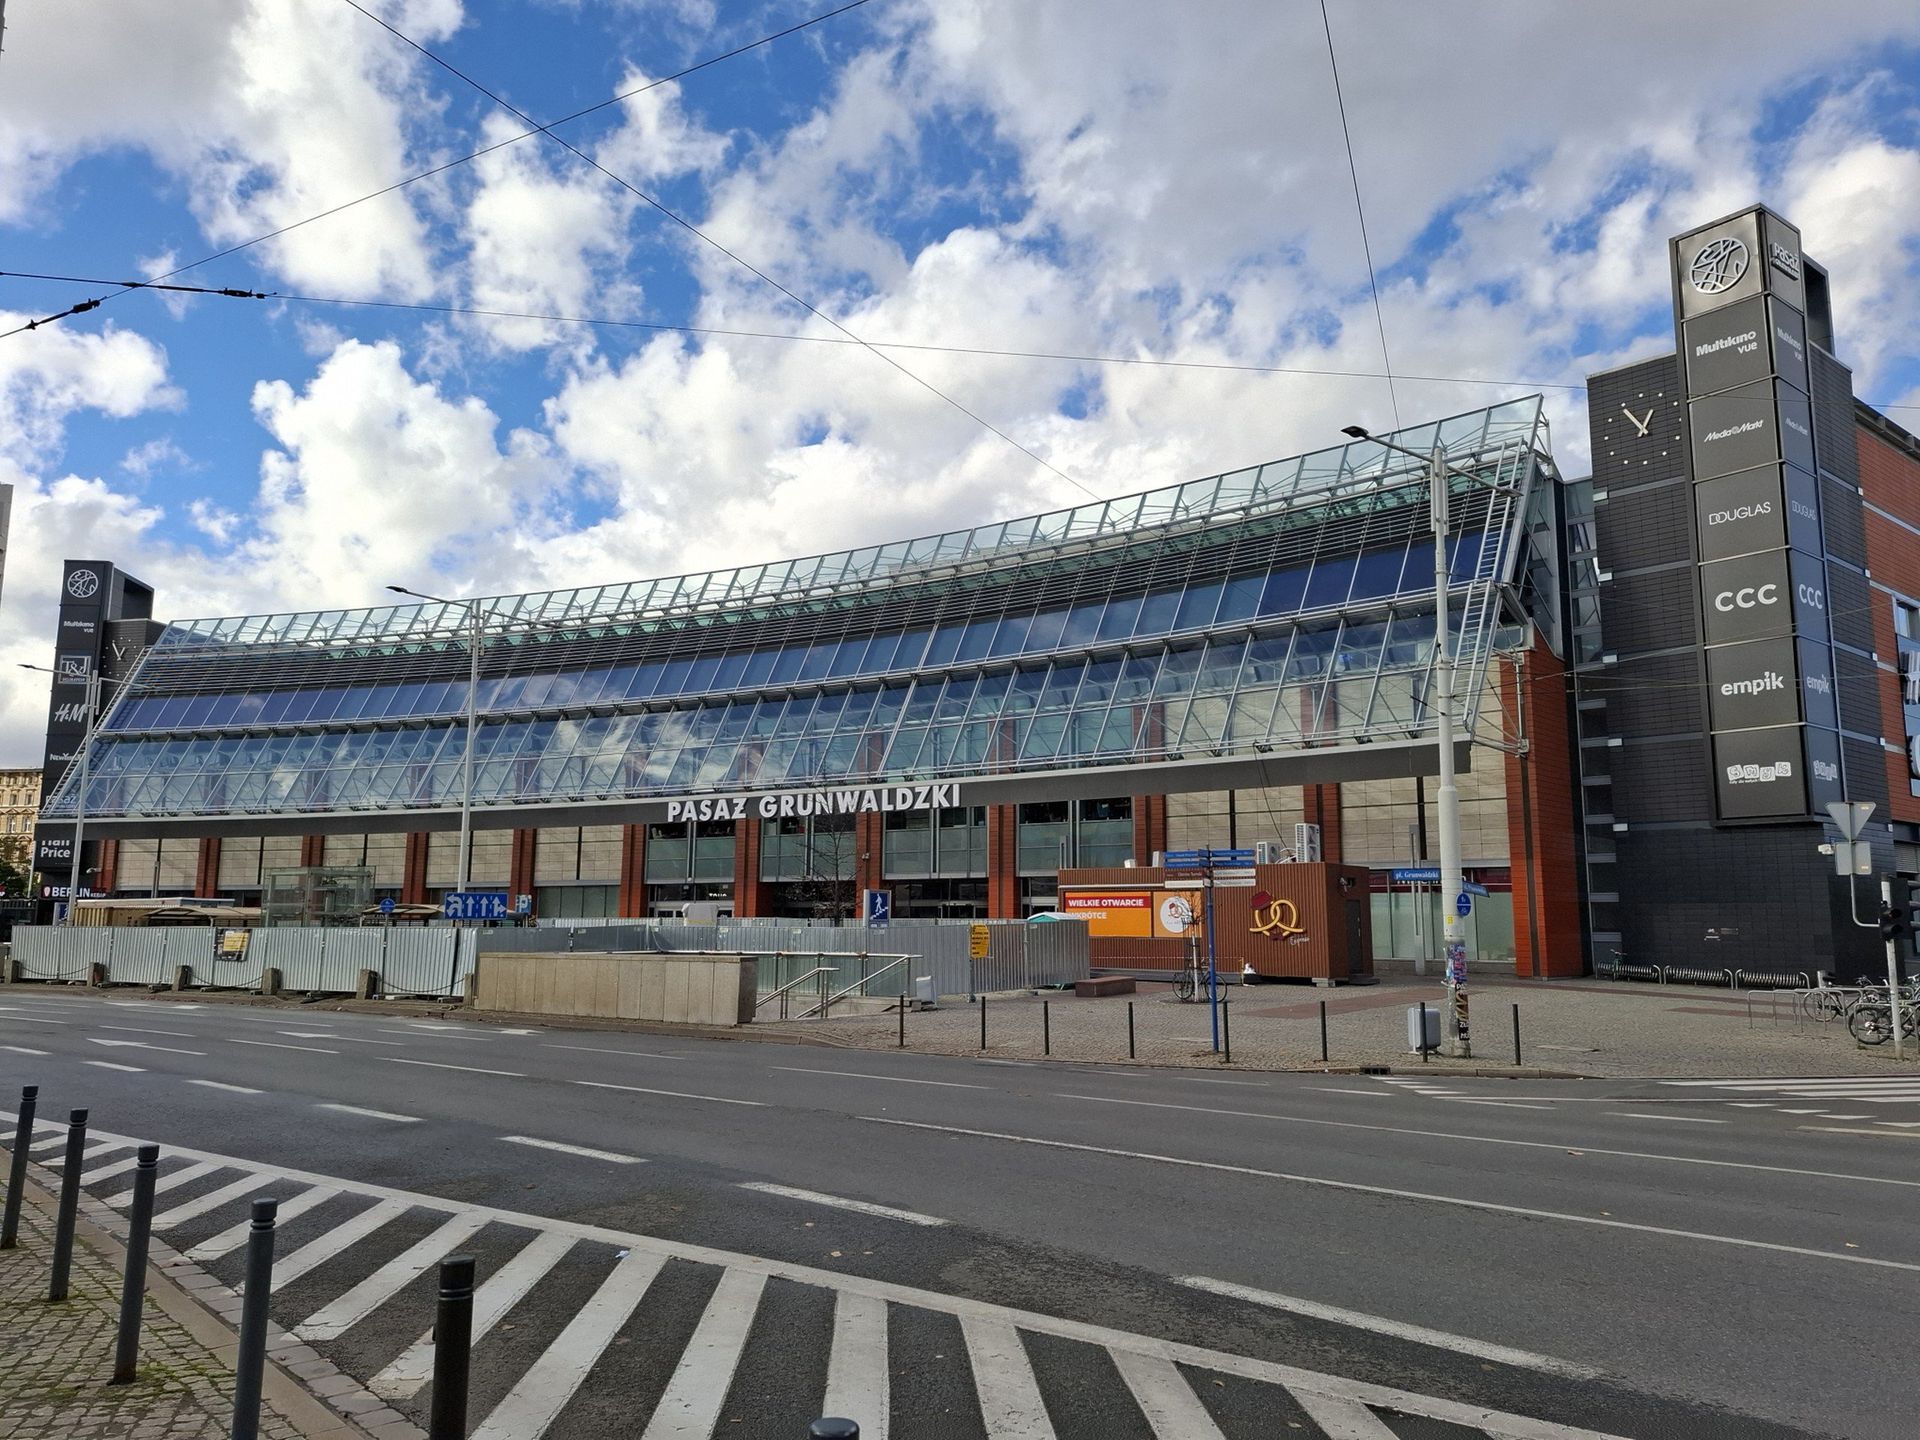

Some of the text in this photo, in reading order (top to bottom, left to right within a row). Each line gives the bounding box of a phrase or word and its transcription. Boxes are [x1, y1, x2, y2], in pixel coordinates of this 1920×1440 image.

[1696, 330, 1757, 356] Multikino
[1708, 501, 1772, 526] DOUGLAS
[1791, 499, 1816, 523] DOUGLAS
[1715, 584, 1778, 612] CCC
[1798, 583, 1823, 610] CCC
[1721, 671, 1784, 696] empik
[1806, 674, 1830, 696] empik
[54, 703, 87, 722] H&M
[759, 784, 960, 817] GRUNWALDZKI
[40, 847, 71, 858] Price
[1068, 898, 1143, 908] WIELKIE OTWARCIE
